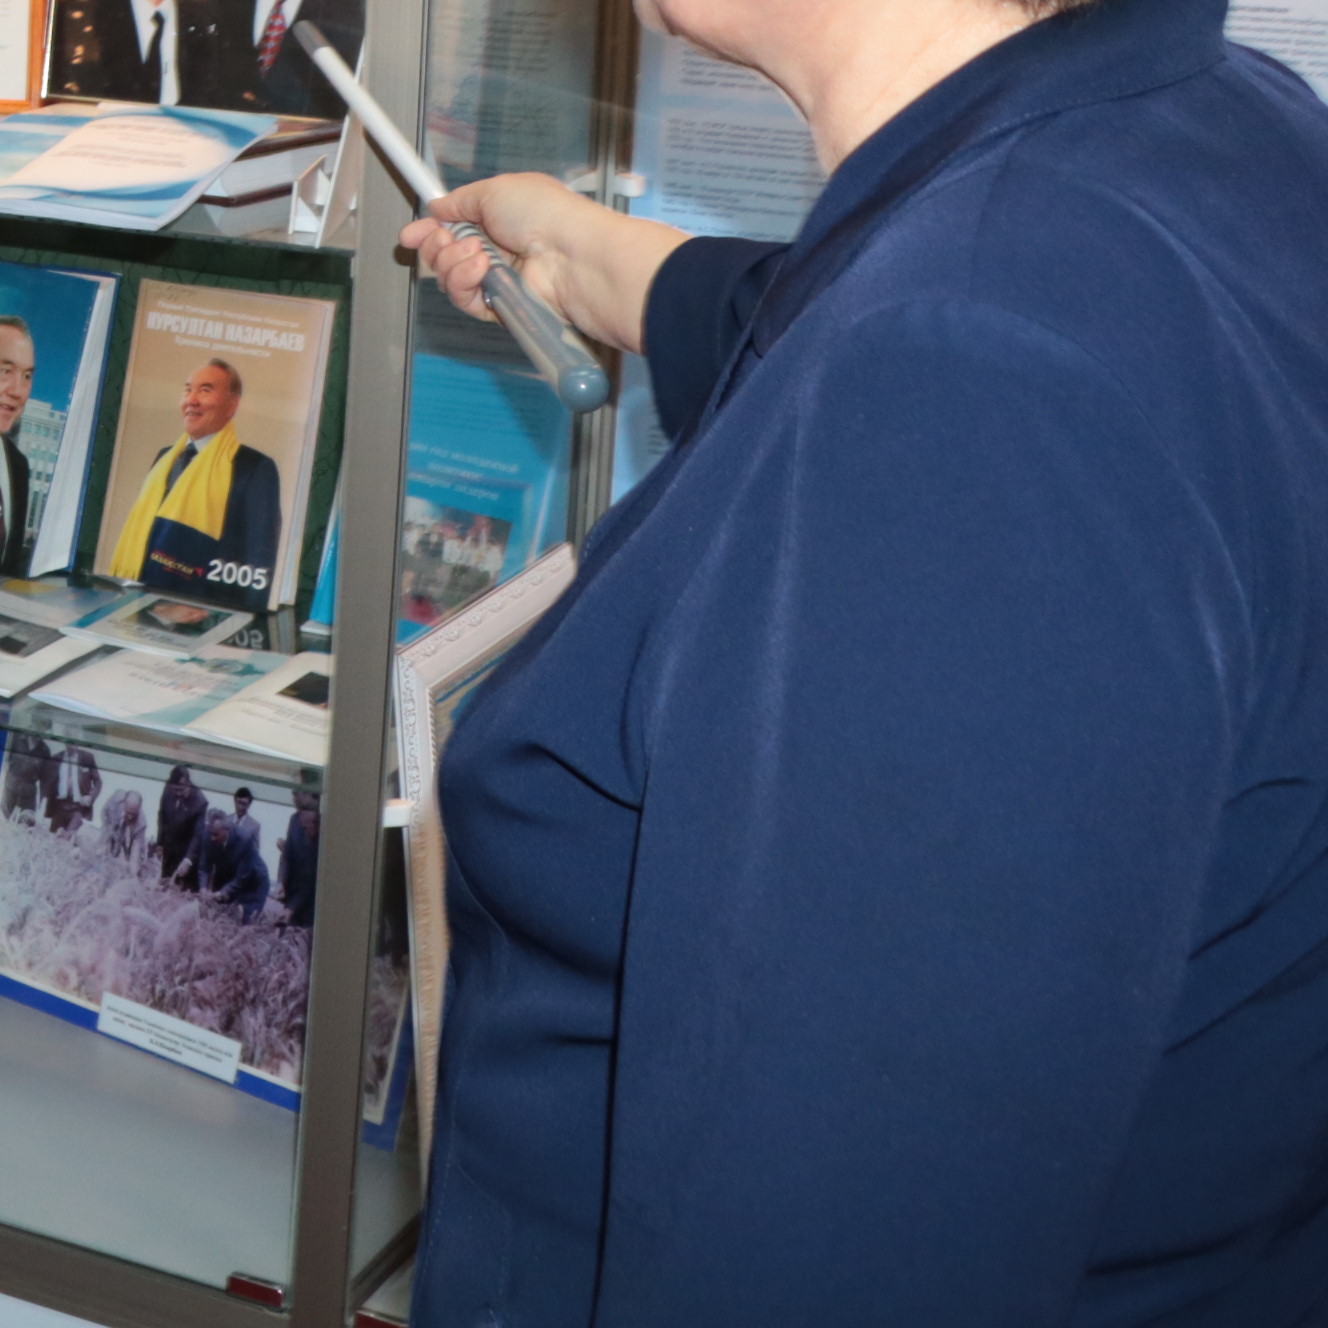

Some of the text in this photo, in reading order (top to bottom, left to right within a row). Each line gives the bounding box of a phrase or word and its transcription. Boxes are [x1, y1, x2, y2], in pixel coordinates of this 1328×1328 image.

[146, 311, 305, 353] НУРСУЛТАН НАЗАРБАЕВ
[206, 558, 269, 591] 2005
